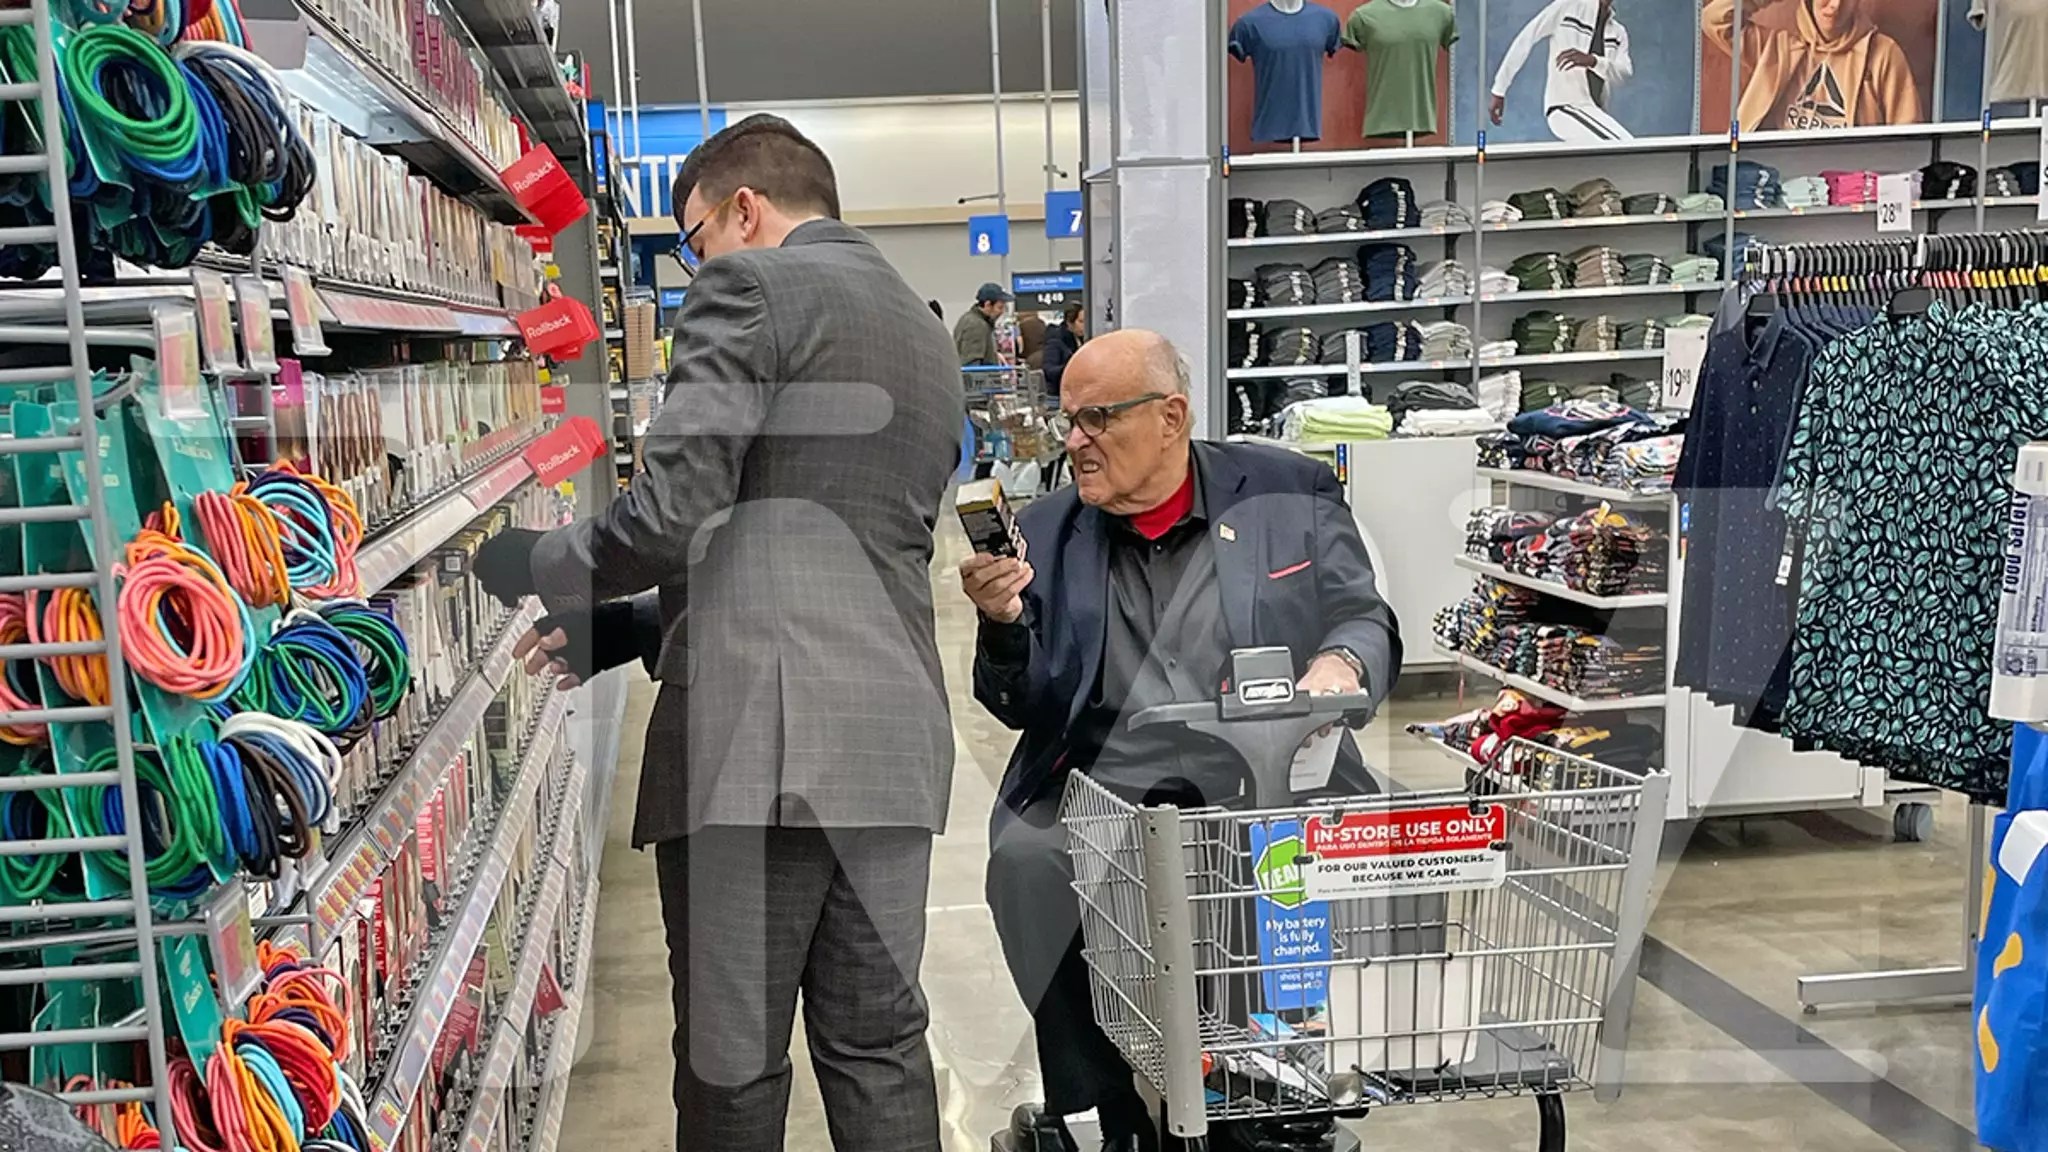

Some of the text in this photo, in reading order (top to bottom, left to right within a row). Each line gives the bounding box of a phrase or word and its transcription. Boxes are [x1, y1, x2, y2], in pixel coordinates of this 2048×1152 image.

[1787, 106, 1848, 130] Ree
[512, 160, 556, 193] Rollback
[1070, 210, 1083, 232] 7
[977, 233, 990, 252] 8
[525, 313, 572, 339] Rollback
[537, 444, 581, 475] Rollback
[1313, 817, 1497, 844] IN-STORE USE ONLY
[1318, 864, 1341, 874] FOR
[1343, 863, 1368, 872] OUR
[1371, 859, 1414, 870] VALUED
[1352, 868, 1461, 883] BECAUSE WE CARE.
[1266, 916, 1327, 932] My batery
[1279, 931, 1289, 943] is
[1279, 970, 1315, 982] shoppng
